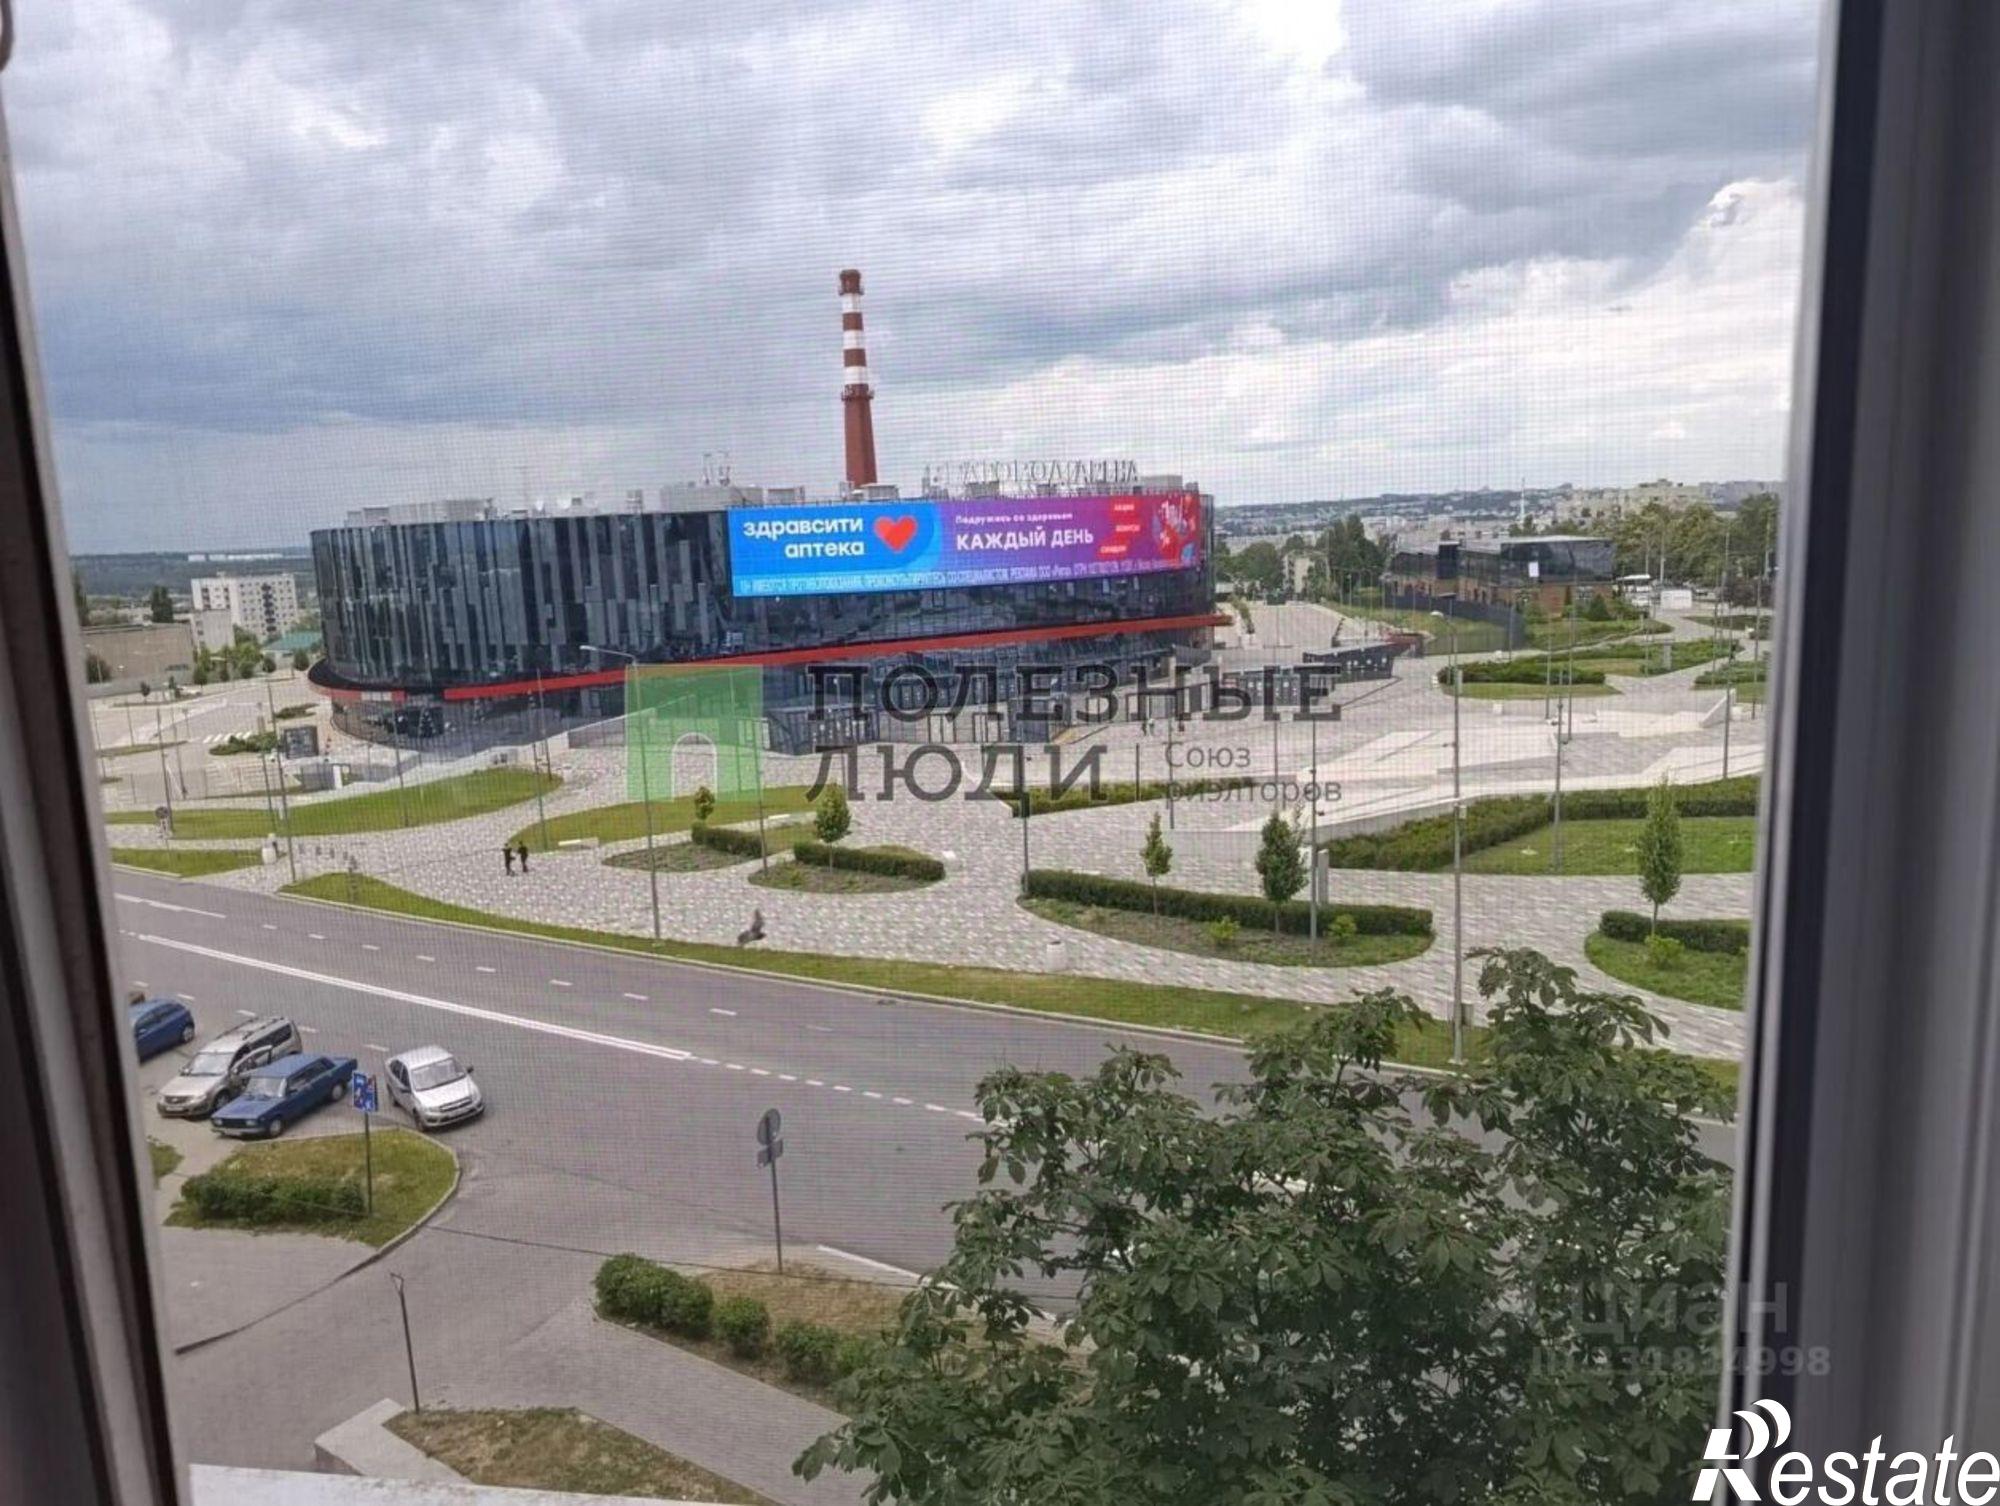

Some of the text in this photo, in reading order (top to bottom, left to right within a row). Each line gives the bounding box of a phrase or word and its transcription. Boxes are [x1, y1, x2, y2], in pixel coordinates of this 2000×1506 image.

[743, 516, 863, 541] здравсити
[956, 525, 1095, 551] КАЖДЫЙ ДЕНЬ
[784, 541, 865, 558] аптека
